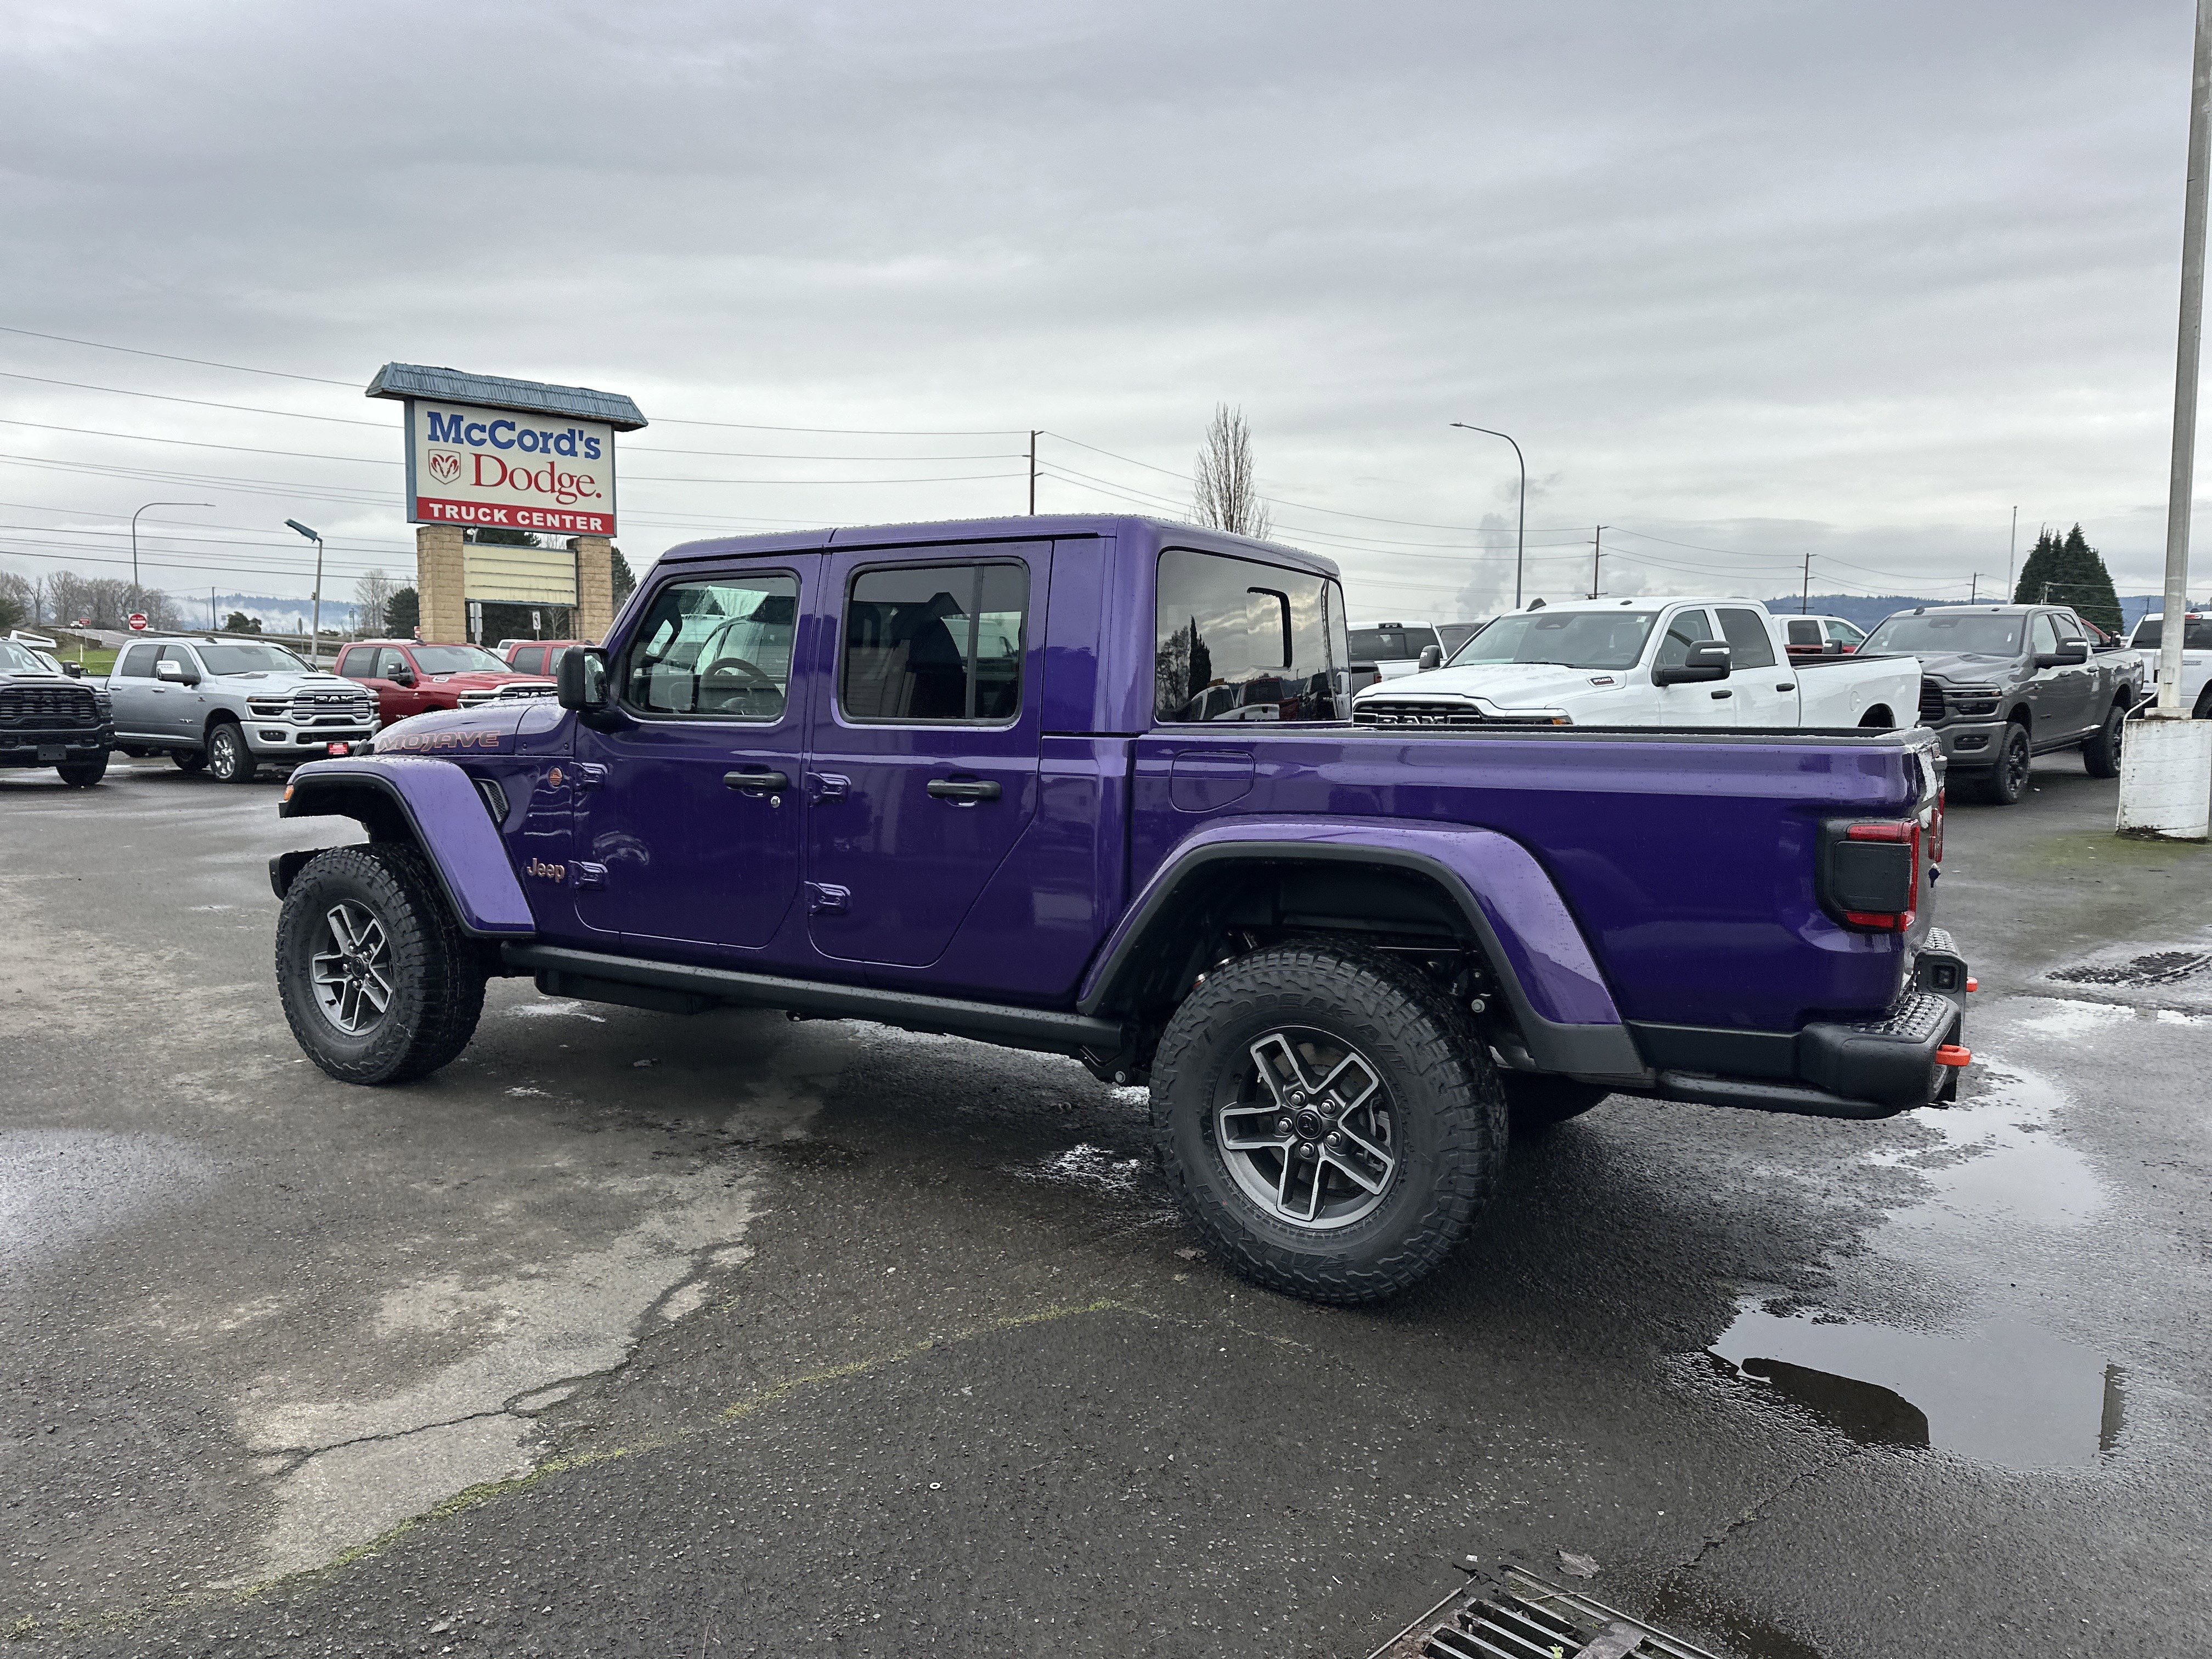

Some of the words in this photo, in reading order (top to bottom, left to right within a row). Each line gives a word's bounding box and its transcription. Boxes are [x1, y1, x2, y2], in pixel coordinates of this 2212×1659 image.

[427, 411, 601, 460] McCord's
[429, 503, 509, 523] TRUCK
[517, 511, 602, 531] CENTER
[1378, 714, 1445, 725] RAM
[375, 731, 500, 752] MOJAVE
[527, 857, 565, 883] Jeep
